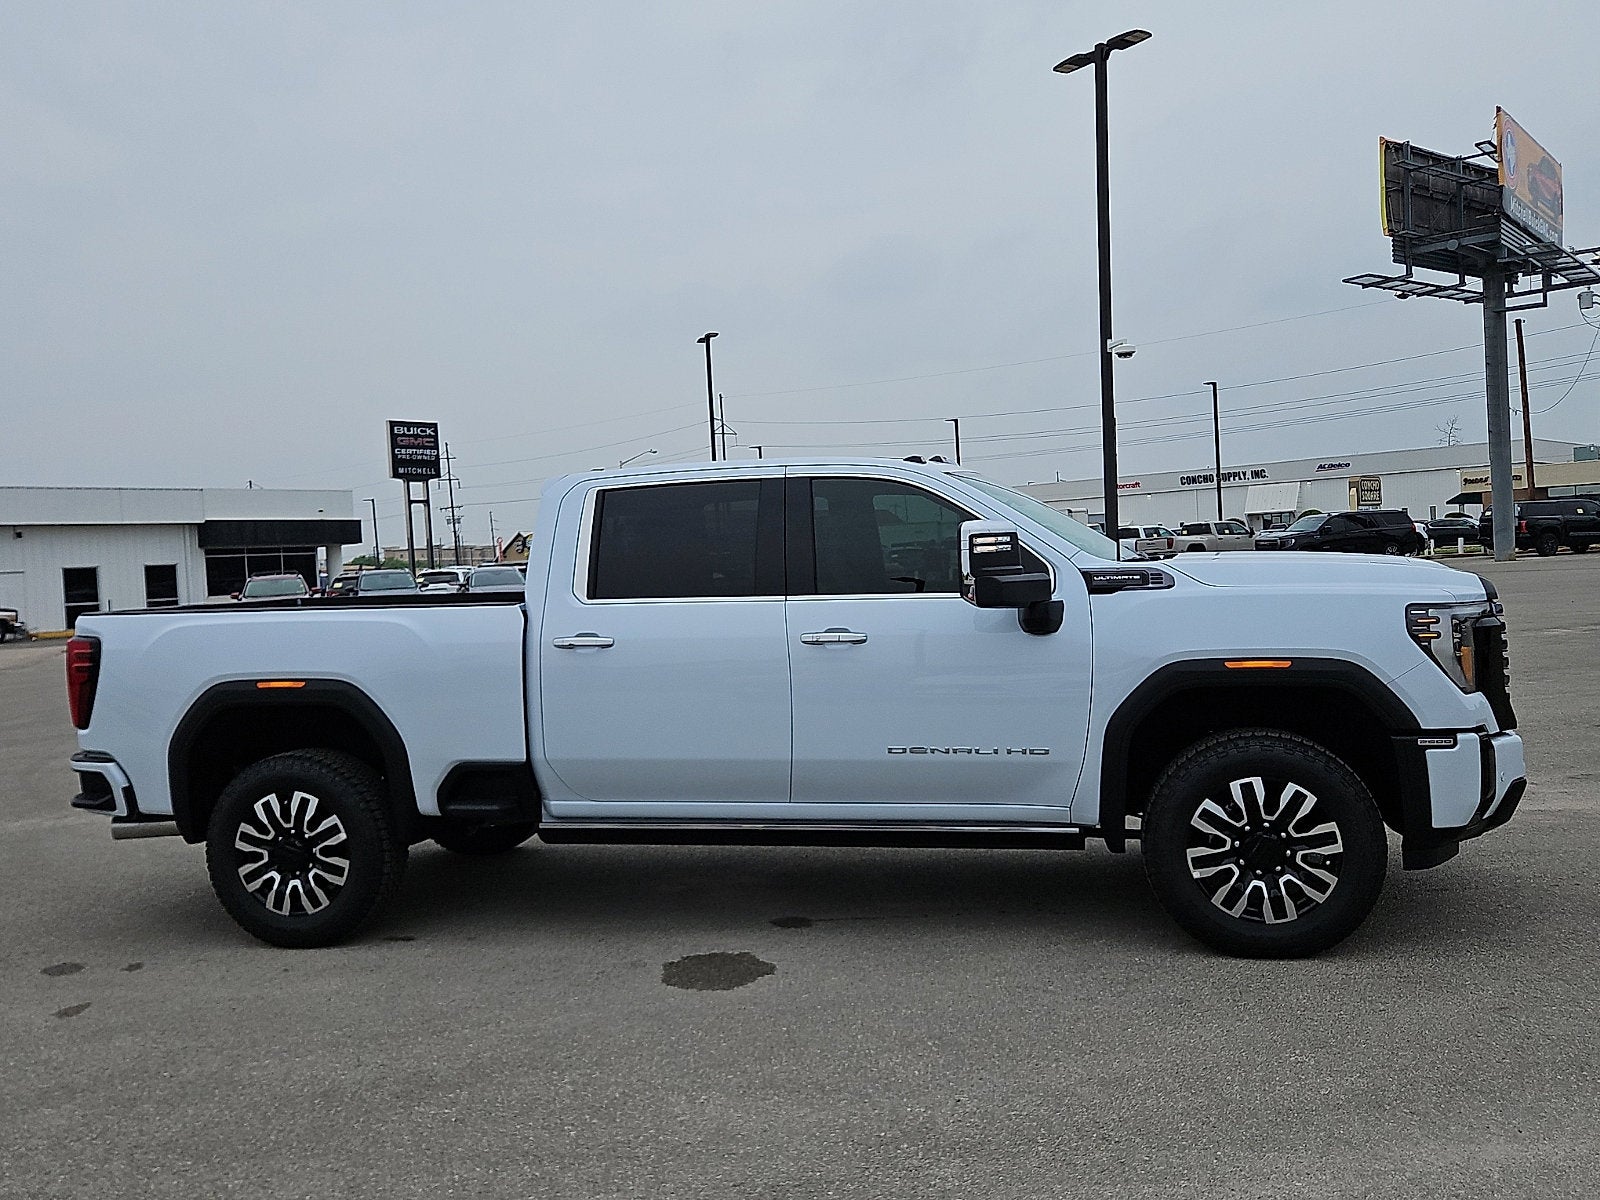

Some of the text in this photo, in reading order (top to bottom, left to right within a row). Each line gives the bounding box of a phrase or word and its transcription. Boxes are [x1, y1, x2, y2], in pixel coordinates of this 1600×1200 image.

[393, 426, 436, 436] BUICK
[396, 436, 435, 446] GMC
[398, 467, 436, 475] MITCHELL
[1180, 473, 1215, 486] CONCHO
[1250, 468, 1269, 480] INC.
[1361, 480, 1380, 490] CONCHO
[886, 745, 1050, 756] DENALI HD
